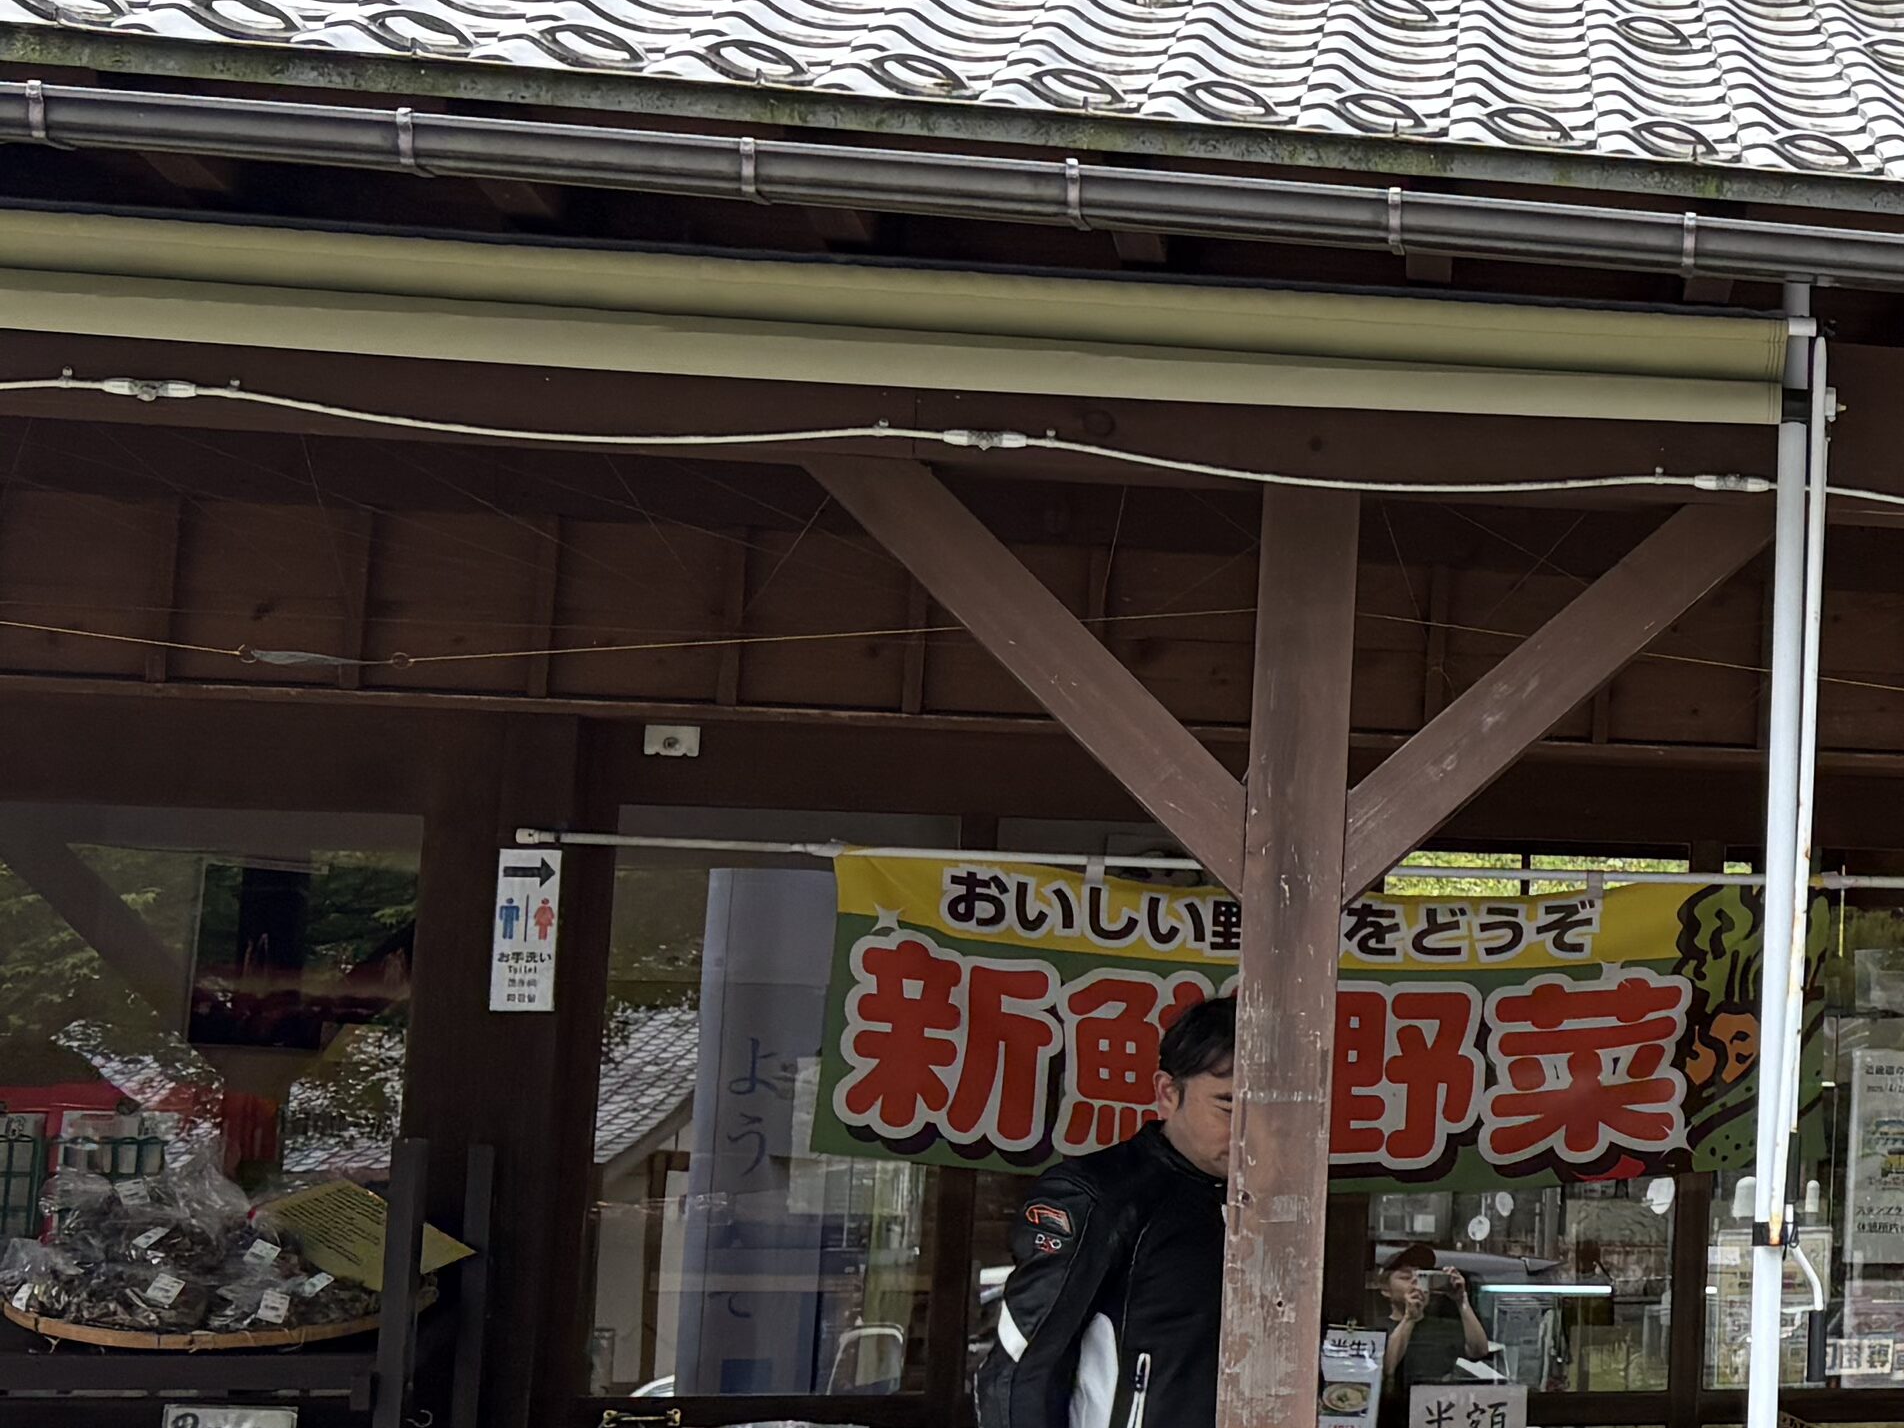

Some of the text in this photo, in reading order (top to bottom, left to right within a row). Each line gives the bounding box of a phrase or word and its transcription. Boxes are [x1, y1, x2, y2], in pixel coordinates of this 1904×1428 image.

[946, 868, 1598, 956] おいしい野をどうぞ
[497, 951, 552, 963] お手洗い
